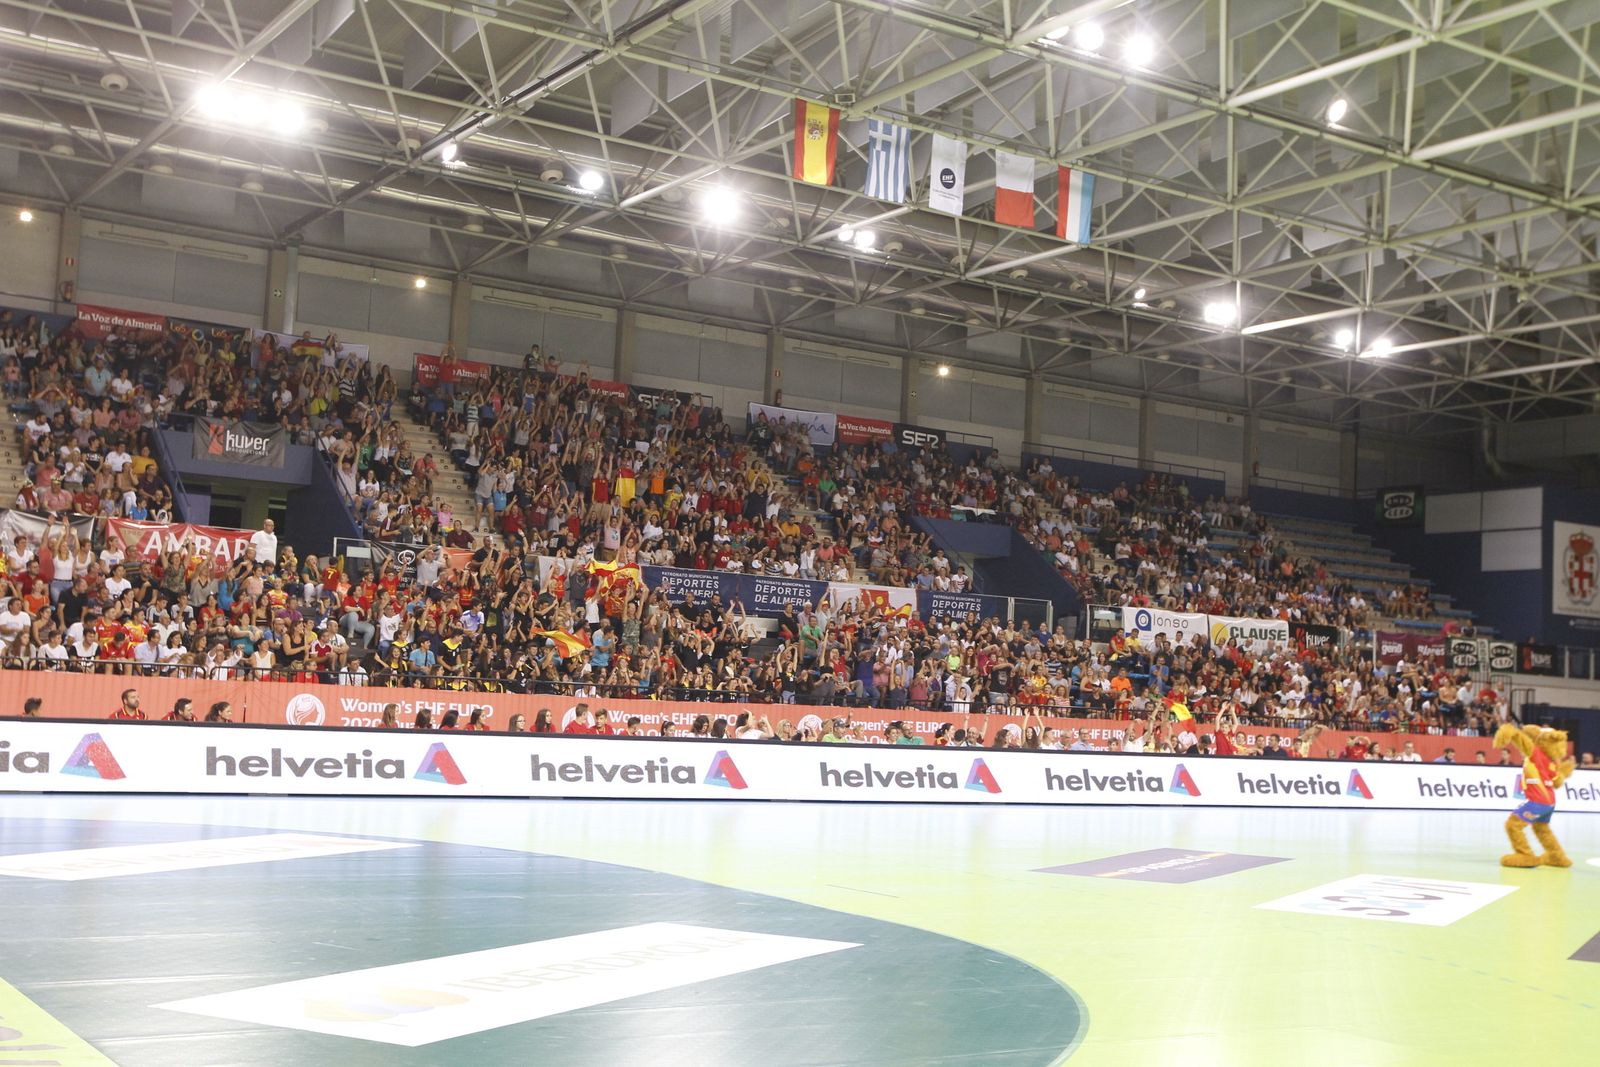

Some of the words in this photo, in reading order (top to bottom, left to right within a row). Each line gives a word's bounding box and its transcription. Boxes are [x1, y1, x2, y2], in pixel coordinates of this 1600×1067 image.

[79, 311, 91, 321] La
[92, 313, 111, 324] Voz
[112, 316, 123, 326] de
[838, 422, 846, 430] La
[847, 423, 859, 431] Voz
[225, 429, 270, 451] kuver
[902, 430, 939, 449] SER
[327, 570, 334, 580] 7
[661, 576, 720, 589] DEPORTES
[678, 587, 719, 598] ALMERI
[755, 584, 811, 597] DEPORTES
[754, 594, 768, 604] DE
[932, 599, 982, 611] DEPORTES
[932, 609, 944, 617] DE
[947, 610, 981, 621] LMEA
[1229, 626, 1287, 641] CLAUSE
[415, 700, 446, 716] EHF
[841, 717, 889, 731] oen's
[1102, 729, 1125, 741] EUR
[1266, 736, 1291, 747] ERO
[205, 746, 406, 780] helvetia
[530, 754, 697, 784] helvetia
[820, 761, 959, 790] helvetia
[1044, 767, 1164, 793] helvetia
[1237, 772, 1341, 796] helvetia
[1417, 777, 1509, 799] helvetia
[443, 934, 764, 992] IBERDROLA
